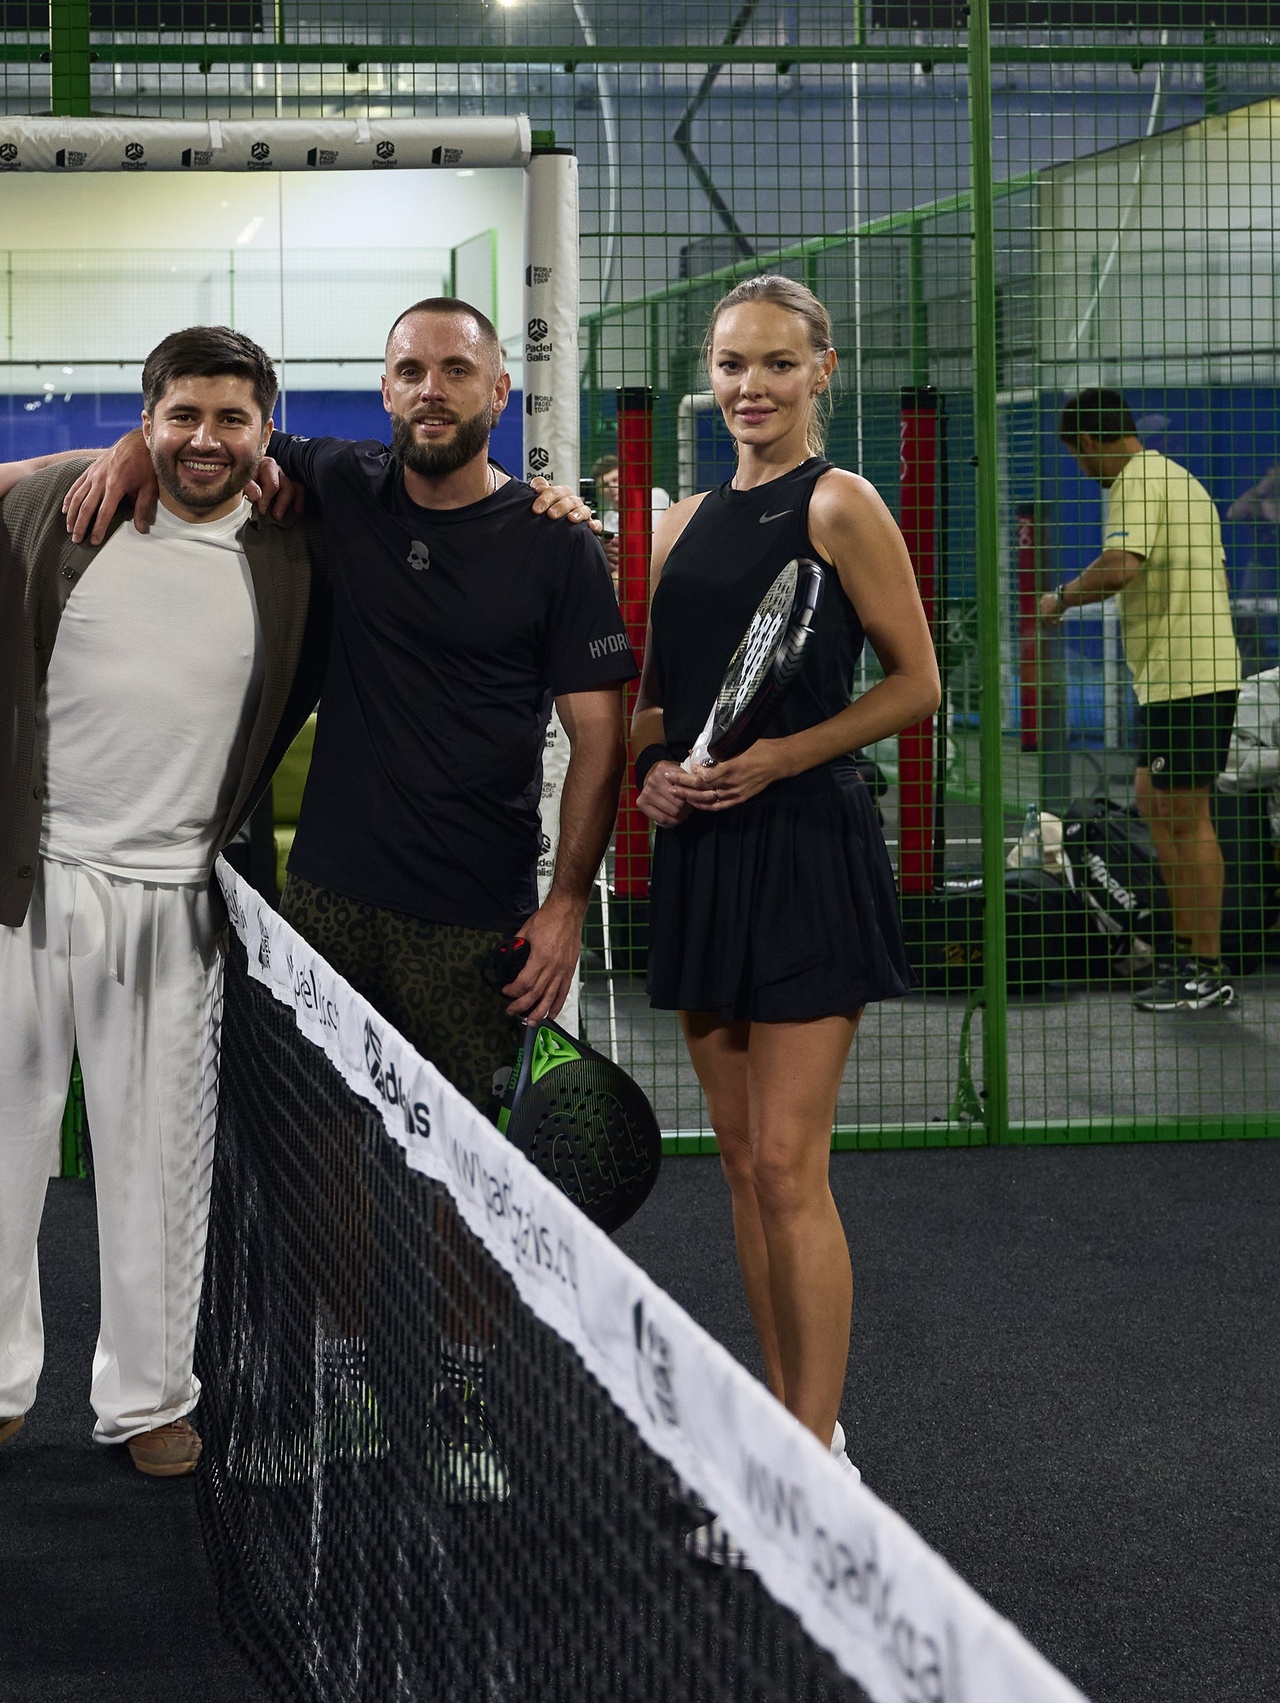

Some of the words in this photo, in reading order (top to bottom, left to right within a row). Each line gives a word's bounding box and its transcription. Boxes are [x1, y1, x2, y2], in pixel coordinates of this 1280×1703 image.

[525, 343, 553, 353] Padel
[526, 352, 551, 363] Galis
[526, 472, 553, 482] Padel
